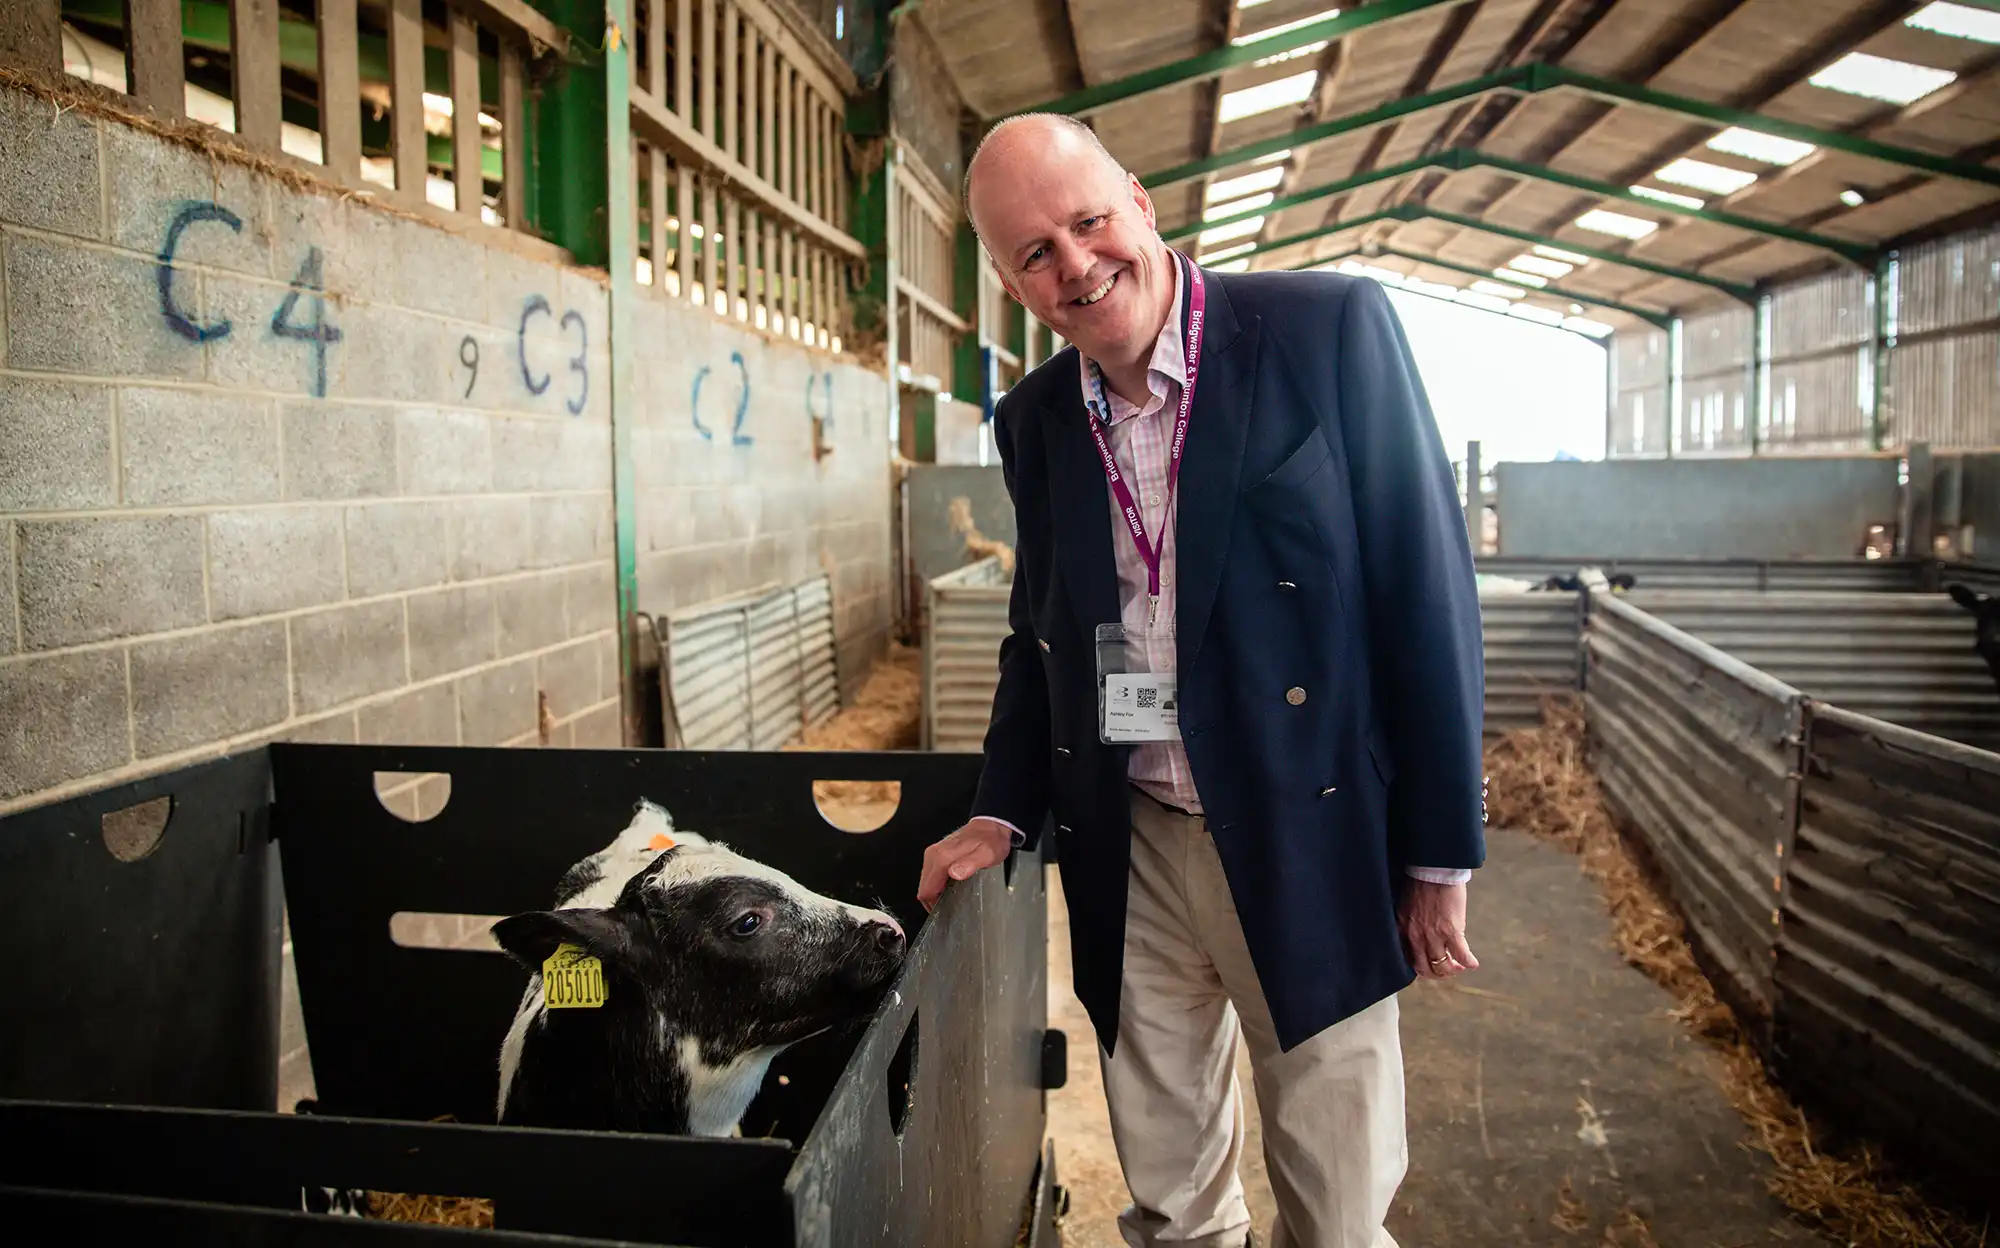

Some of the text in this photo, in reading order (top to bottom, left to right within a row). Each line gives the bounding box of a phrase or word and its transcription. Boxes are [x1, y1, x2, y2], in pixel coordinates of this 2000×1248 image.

[157, 201, 342, 397] C4
[459, 335, 480, 398] 9
[518, 293, 588, 415] C3
[1172, 310, 1203, 459] Bridgwater & Taunton College
[691, 351, 754, 446] C2
[1095, 431, 1120, 482] Bridgwater
[1126, 505, 1143, 537] VISITOR
[547, 969, 601, 1004] 205010
